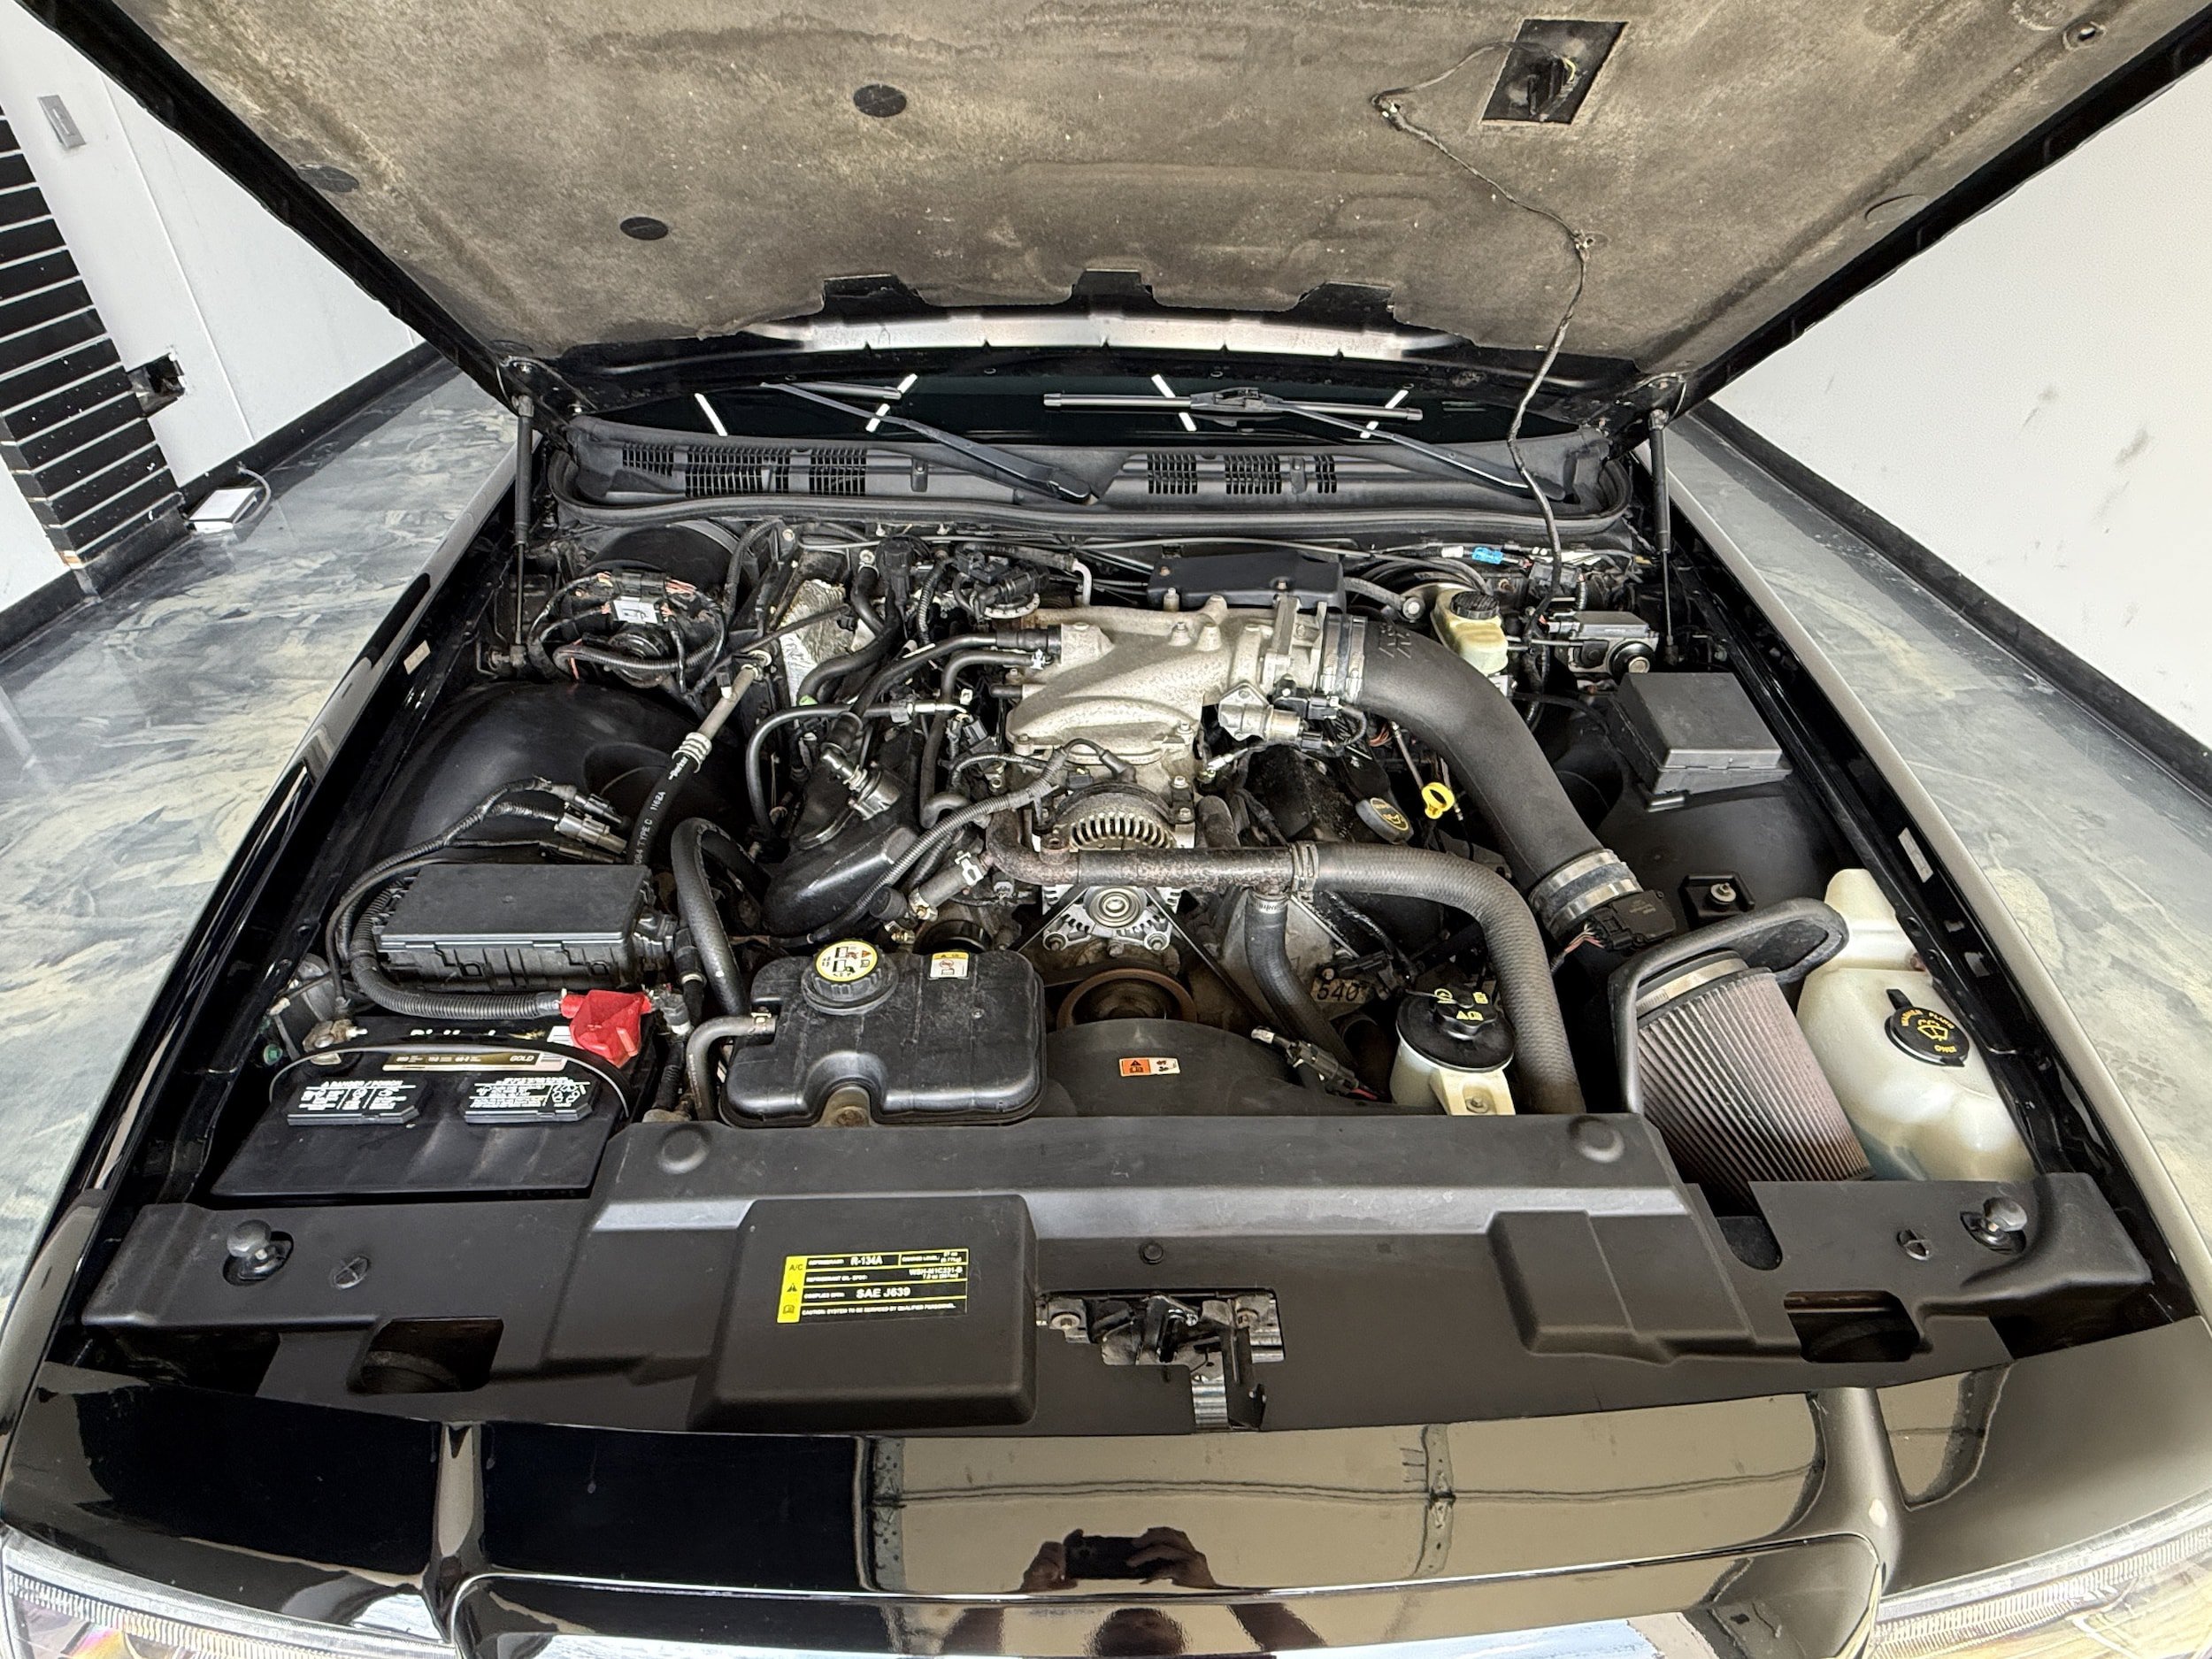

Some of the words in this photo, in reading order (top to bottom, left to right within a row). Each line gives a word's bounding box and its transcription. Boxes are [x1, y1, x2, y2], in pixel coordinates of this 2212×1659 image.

[637, 826, 650, 846] TYPE
[850, 1255, 883, 1265] R-134A
[856, 1288, 882, 1299] SAE
[883, 1286, 911, 1297] J639
